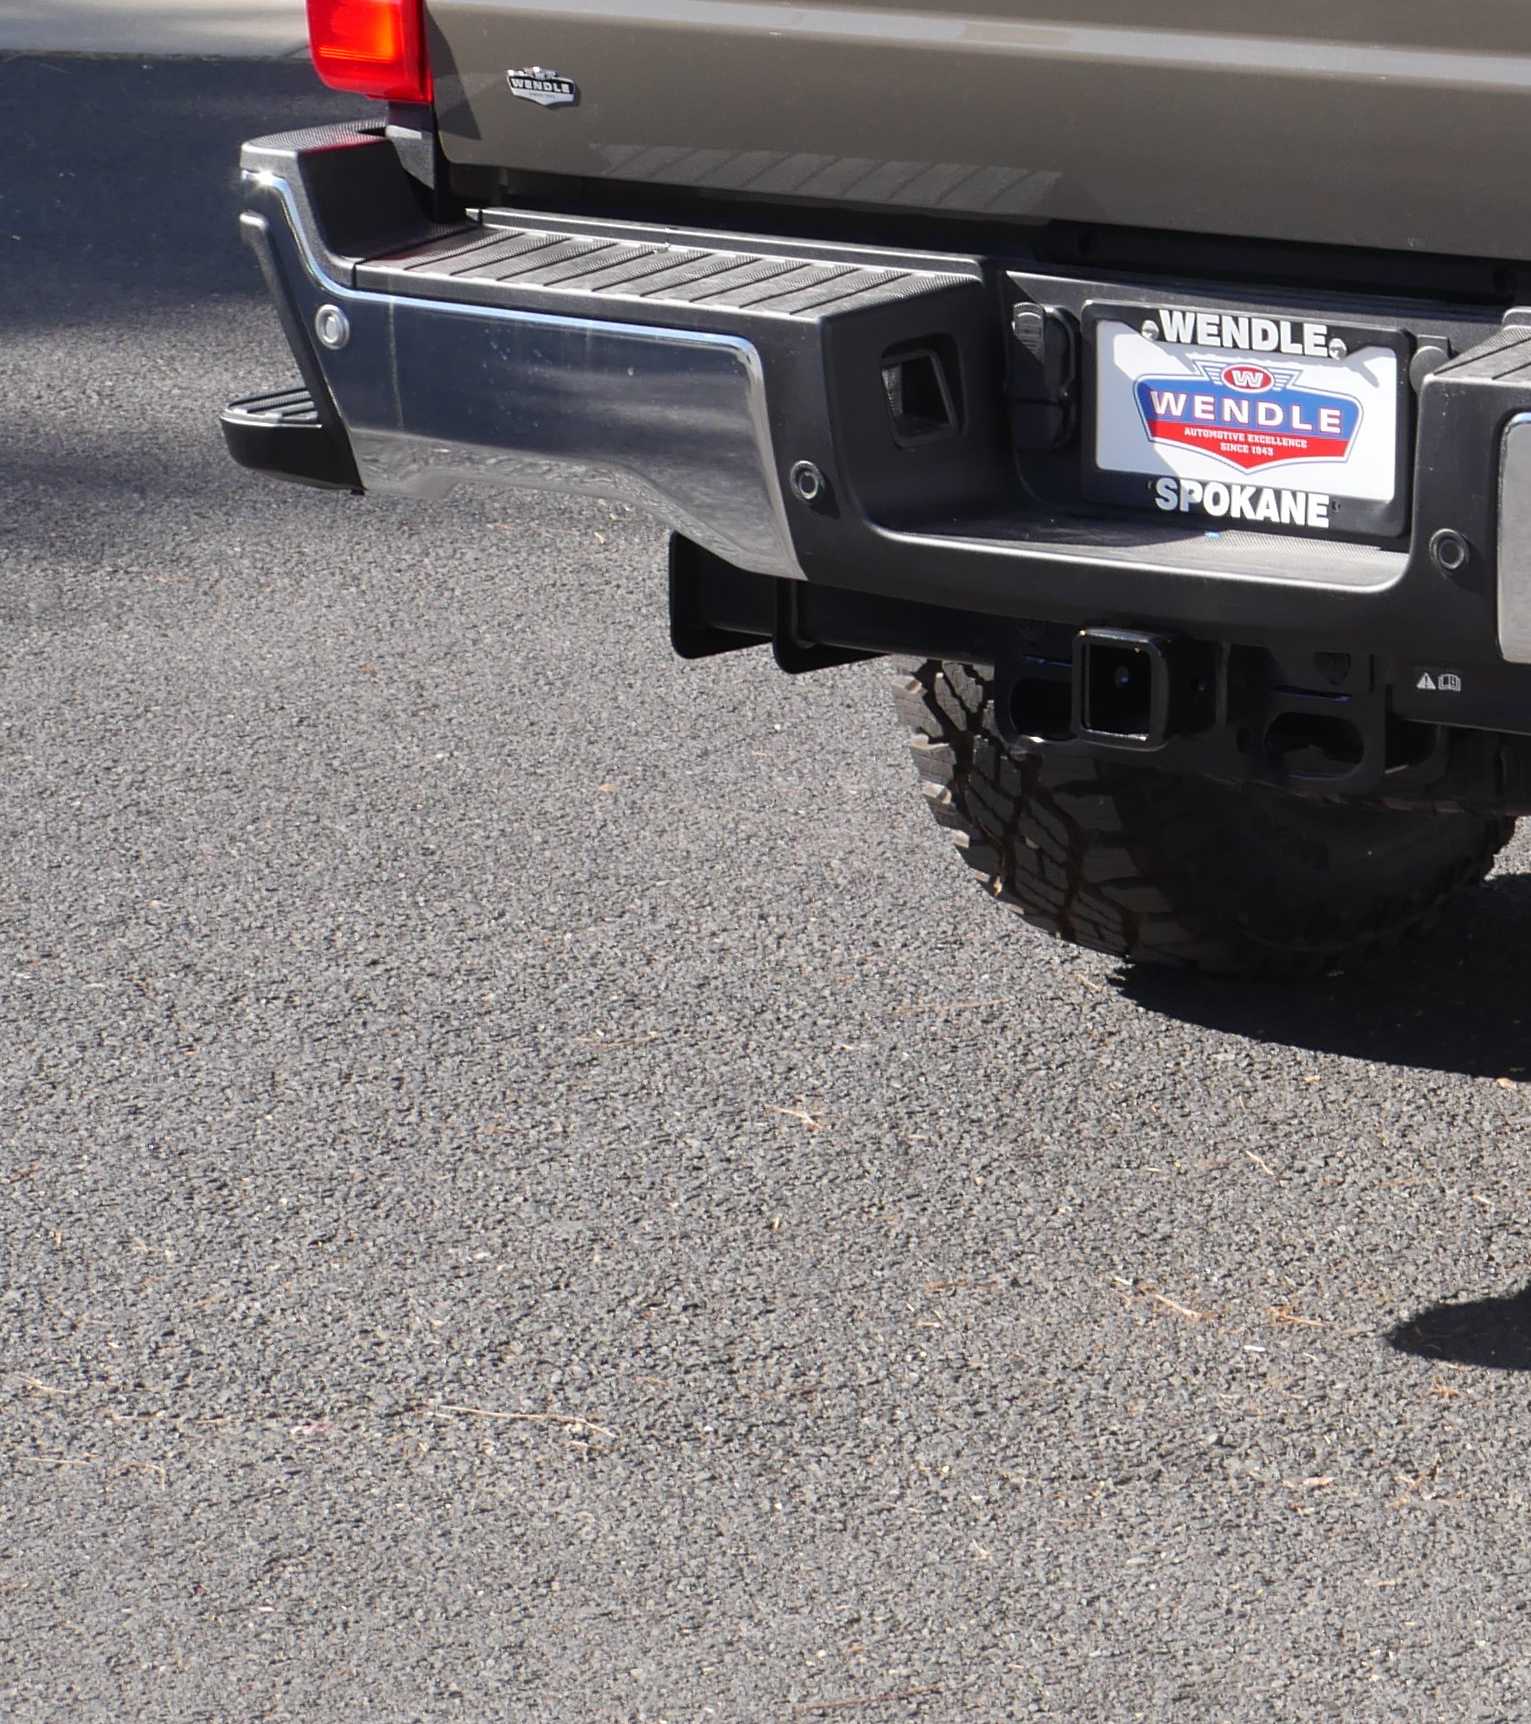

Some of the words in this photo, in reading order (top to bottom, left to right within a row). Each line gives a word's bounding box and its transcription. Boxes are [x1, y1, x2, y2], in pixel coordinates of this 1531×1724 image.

[511, 78, 571, 94] WENDLE
[1159, 310, 1328, 358] WENDLE
[1231, 370, 1264, 389] W
[1150, 390, 1342, 434] WENDLE
[1184, 427, 1246, 442] AUTOMOTIVE
[1247, 432, 1308, 449] EXCELLENCE
[1220, 442, 1250, 454] SINCE
[1155, 477, 1330, 528] SPOKANE
